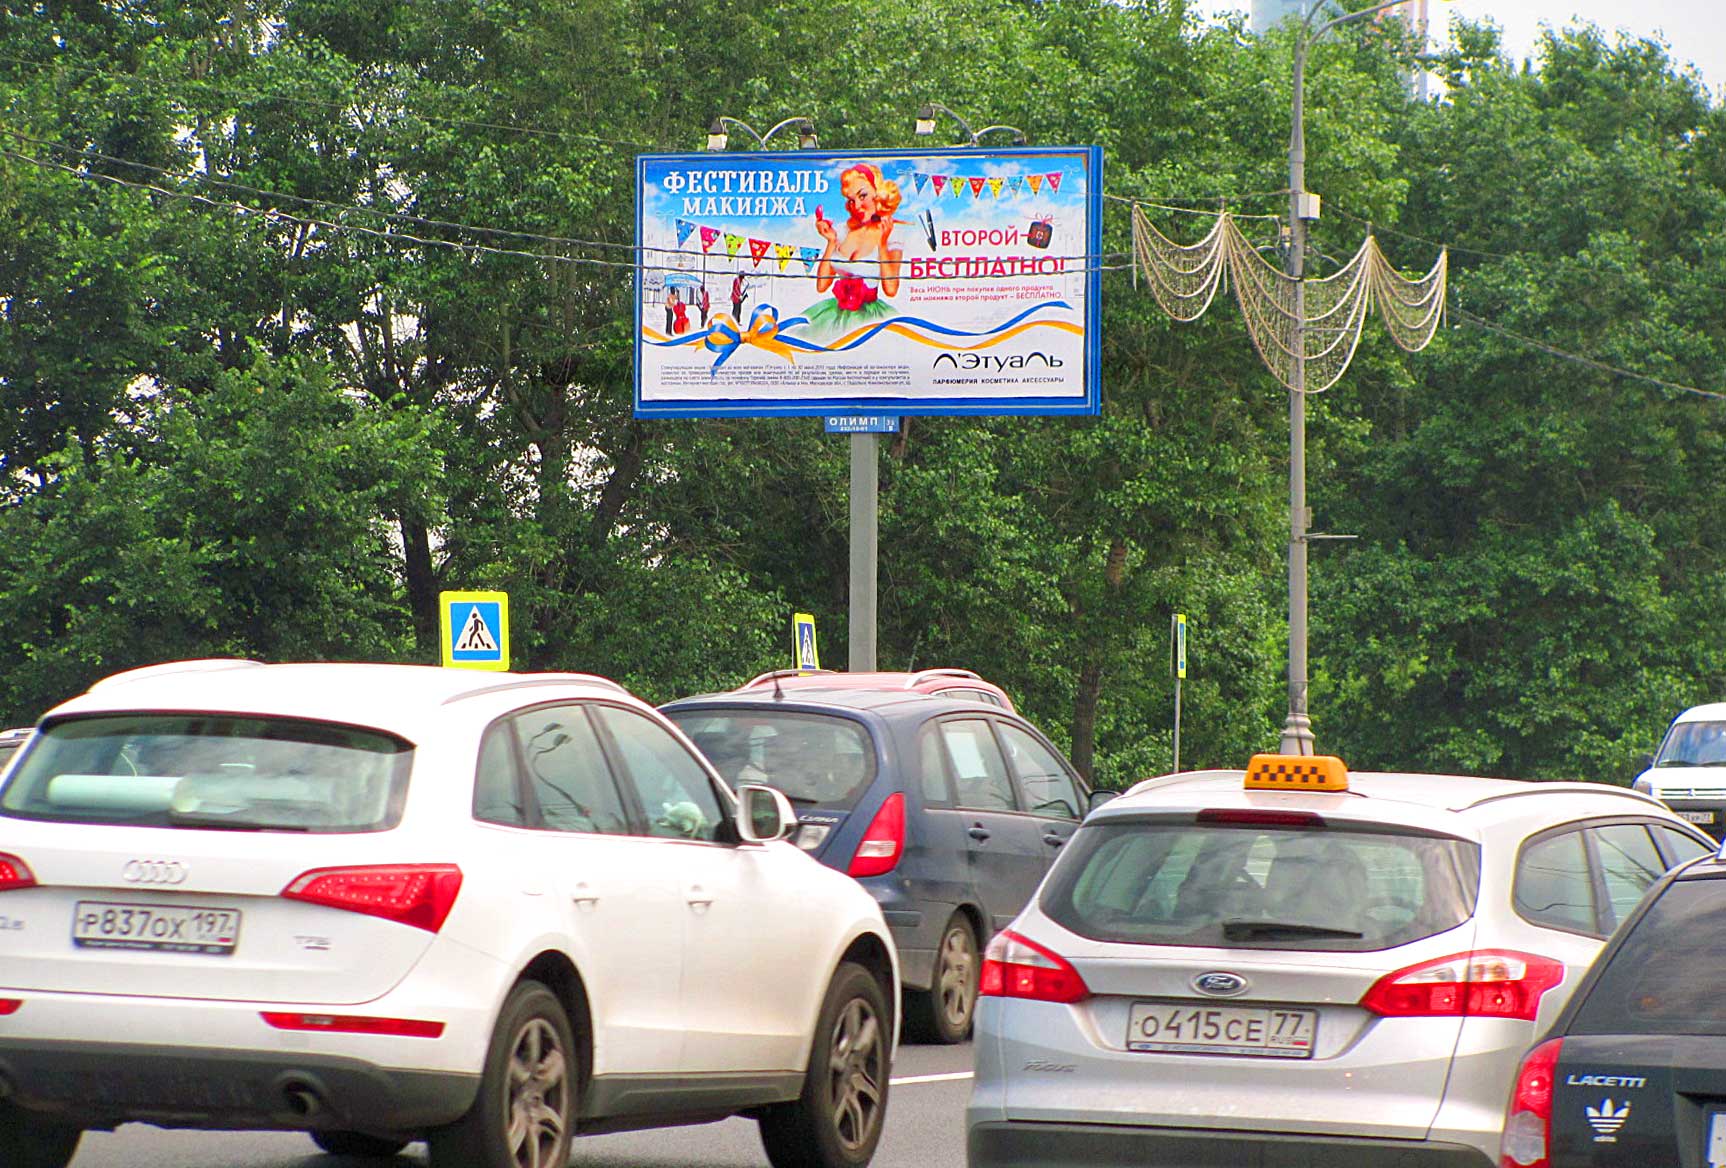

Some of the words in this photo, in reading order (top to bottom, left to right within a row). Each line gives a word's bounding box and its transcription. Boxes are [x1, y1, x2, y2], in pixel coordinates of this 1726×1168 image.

[663, 170, 829, 194] ФЕСТИВАЛЬ
[682, 196, 808, 216] МАКИЯЖА
[941, 225, 1018, 246] ВТОРОЙ
[910, 256, 1065, 279] БЕСПЛАТНО!
[829, 417, 878, 426] ОЛИМП
[1274, 1012, 1305, 1036] 77
[1567, 1074, 1648, 1088] LACETTI
